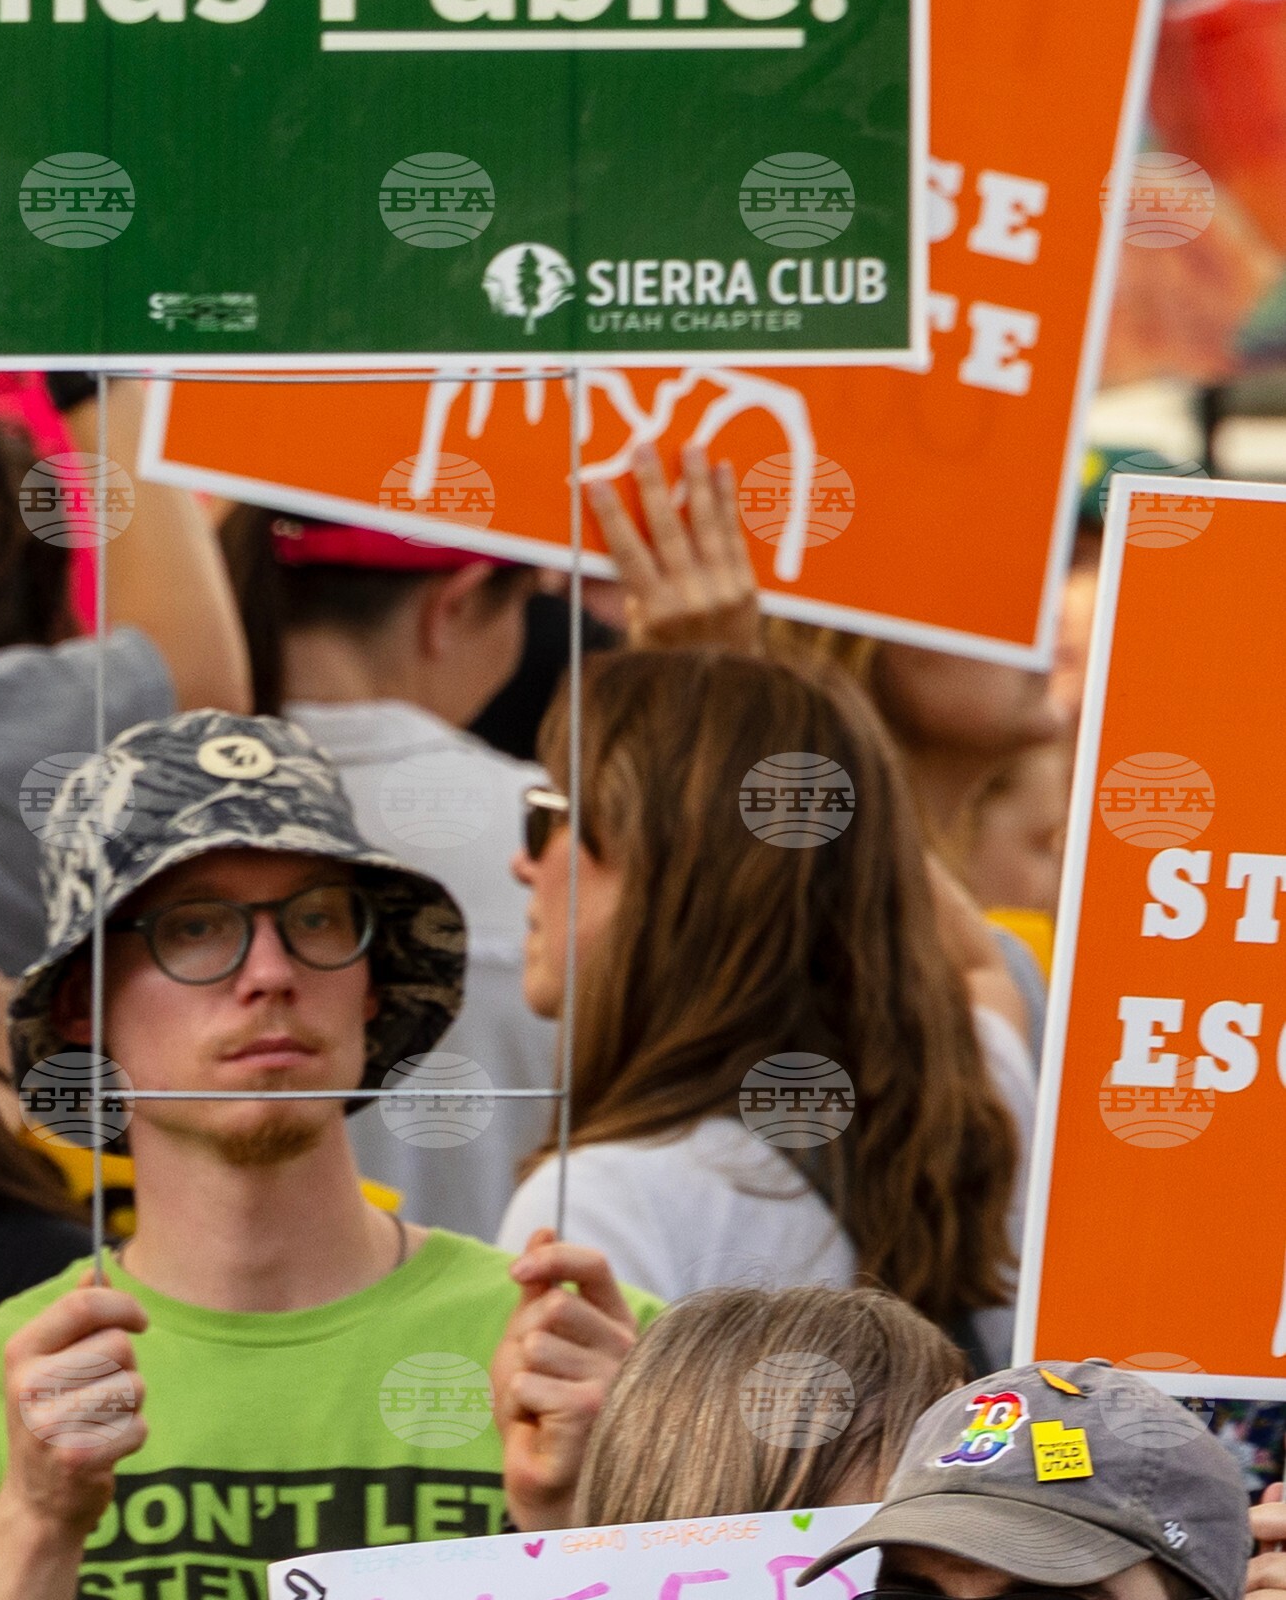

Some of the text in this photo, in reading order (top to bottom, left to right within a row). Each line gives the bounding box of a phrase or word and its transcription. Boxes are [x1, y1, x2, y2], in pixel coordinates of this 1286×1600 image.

[585, 256, 888, 307] SIERRA CLUB
[586, 309, 803, 333] UTAH CHAPTER
[1109, 995, 1286, 1094] ES
[1041, 1459, 1086, 1473] UTAH
[559, 1528, 629, 1555] GRAND
[639, 1517, 763, 1550] STAIRCASE
